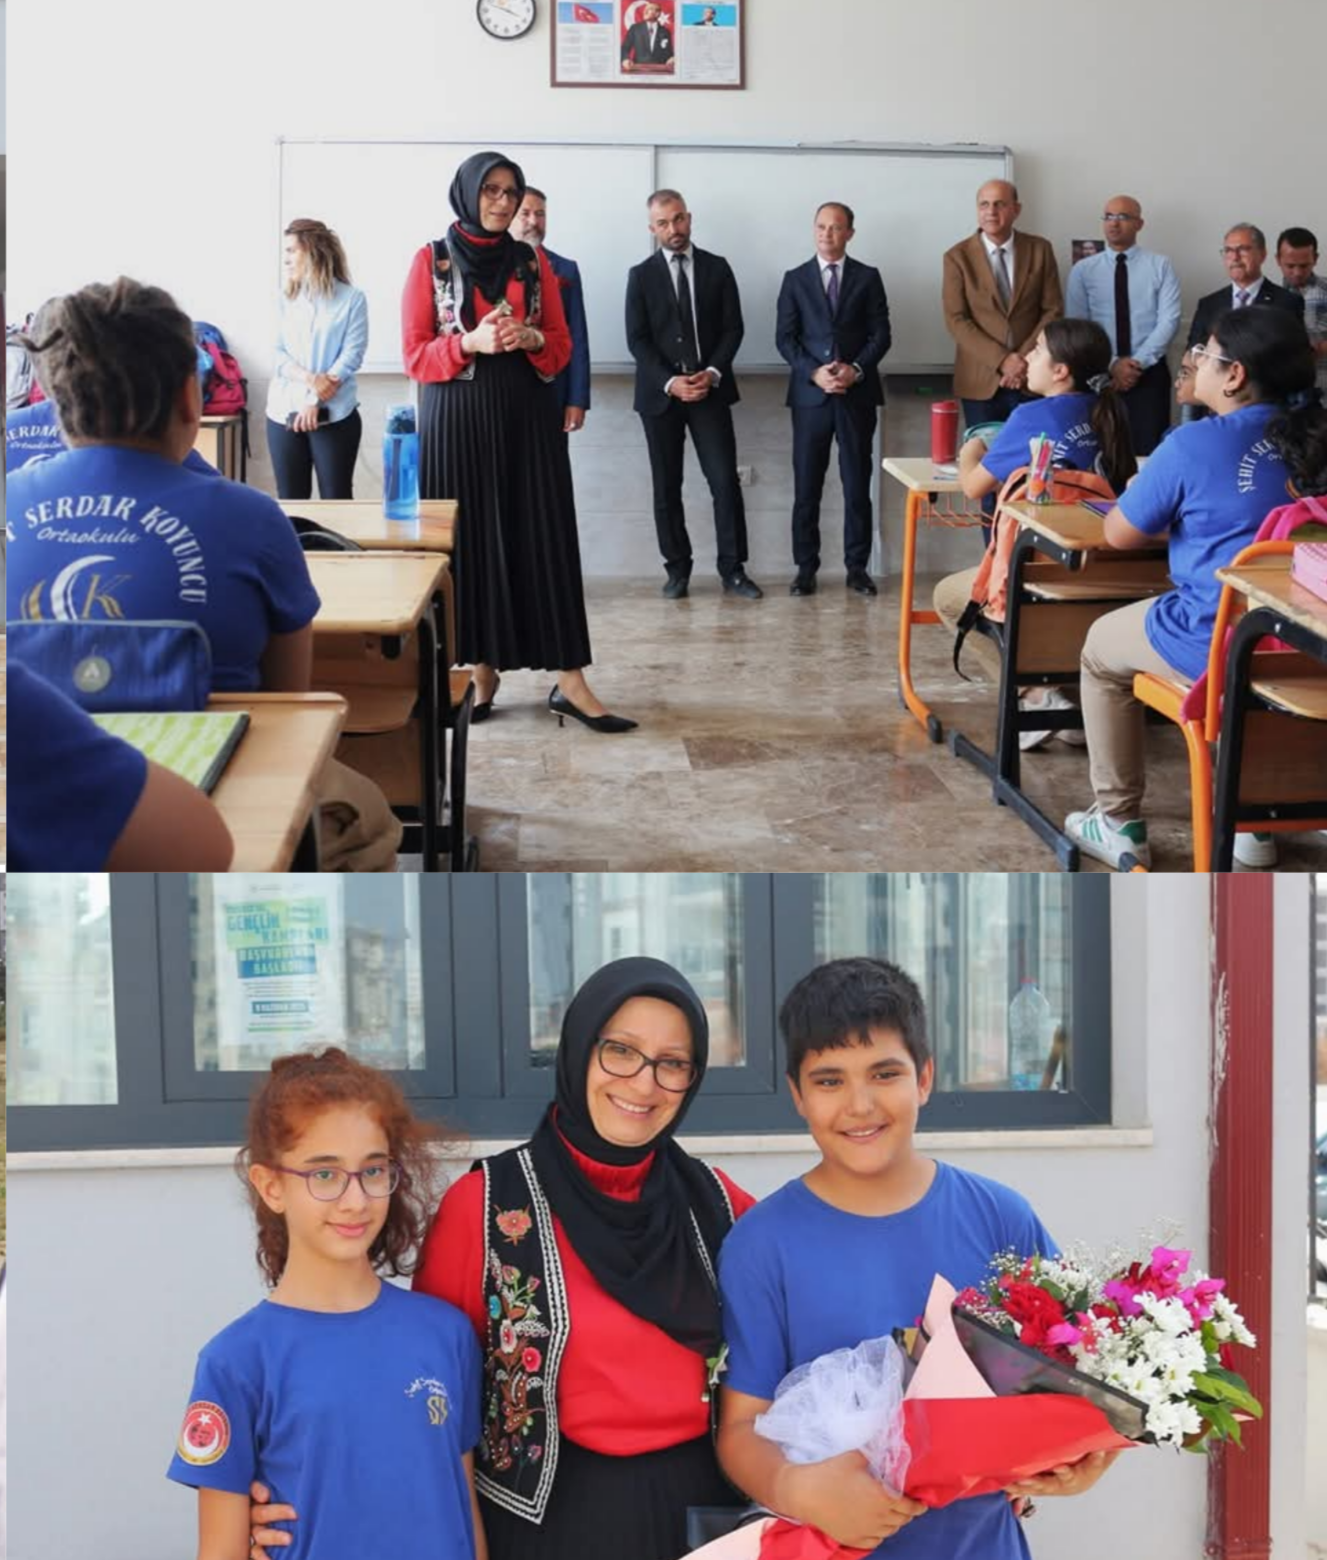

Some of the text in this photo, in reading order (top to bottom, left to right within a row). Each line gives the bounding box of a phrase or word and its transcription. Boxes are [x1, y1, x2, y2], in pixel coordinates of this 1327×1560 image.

[24, 494, 208, 605] SERDAR KOYUNCU
[37, 526, 141, 544] Ortaokulu
